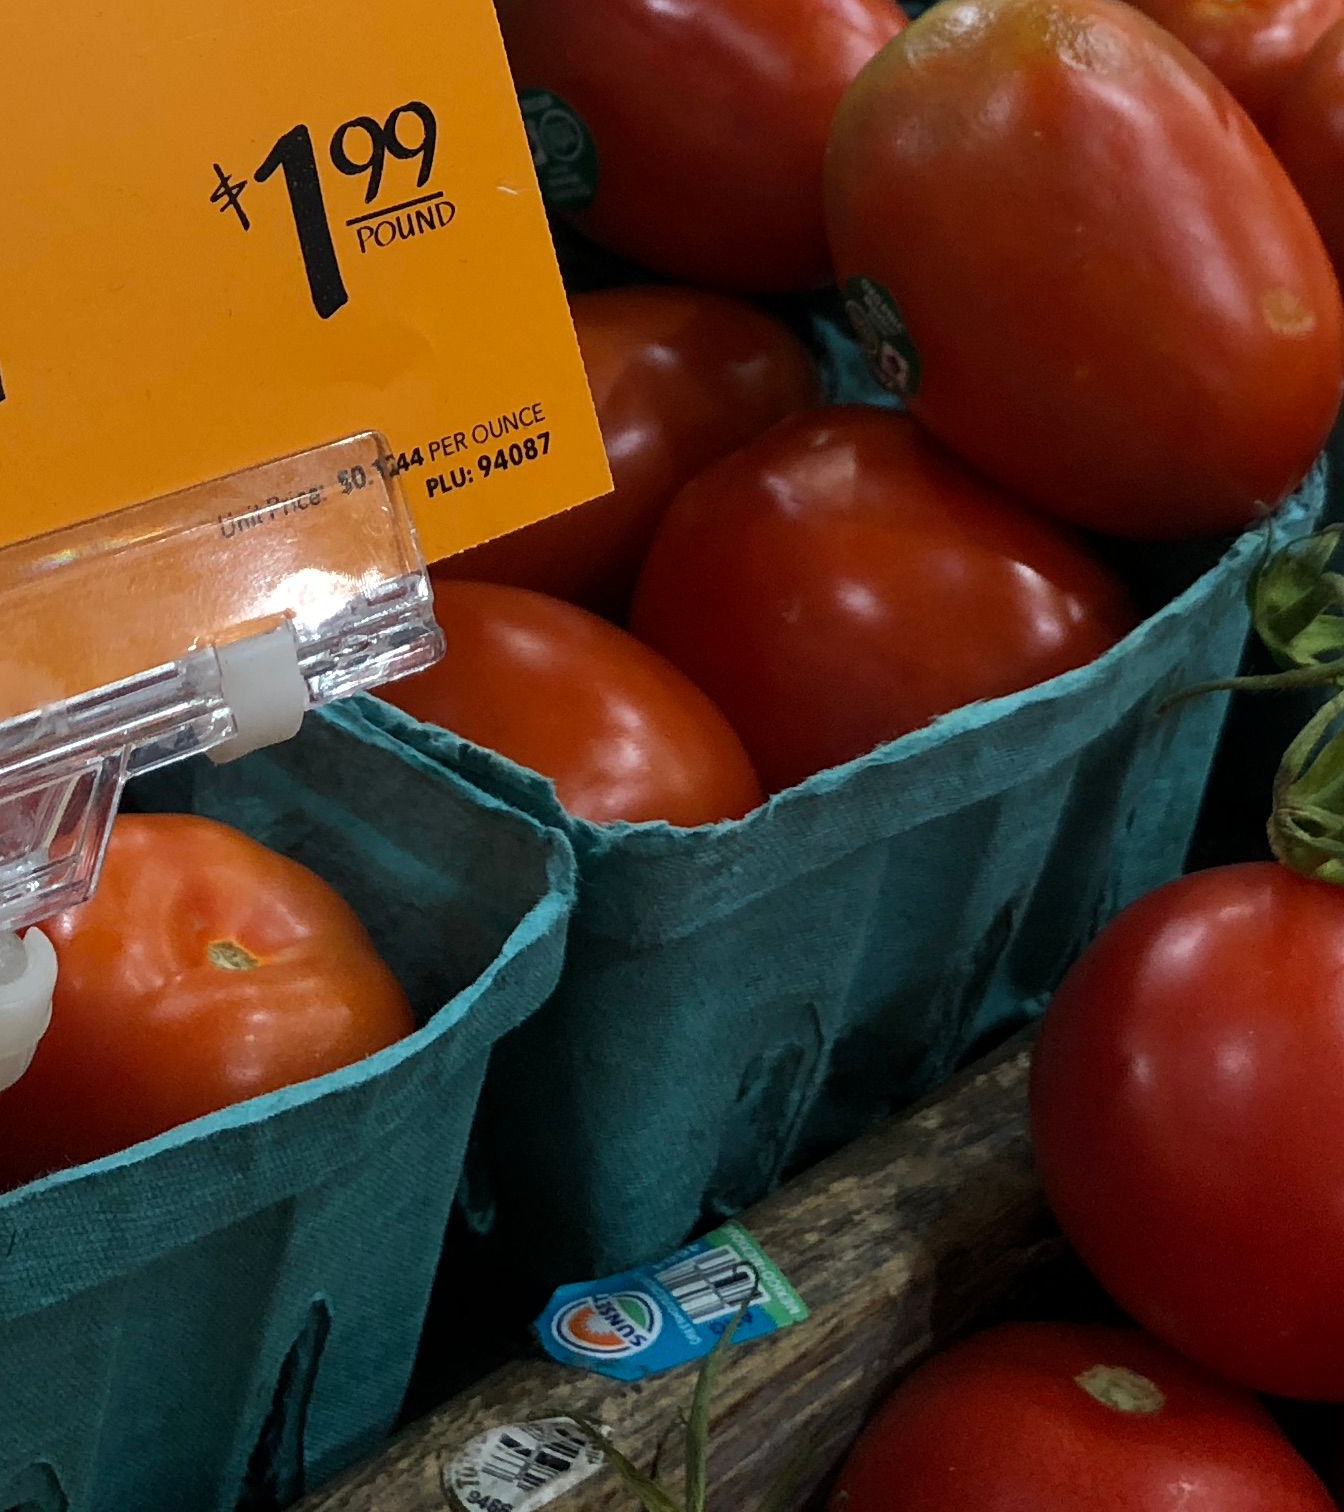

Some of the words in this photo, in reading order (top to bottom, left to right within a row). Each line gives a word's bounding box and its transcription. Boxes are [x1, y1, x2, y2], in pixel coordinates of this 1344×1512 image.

[356, 200, 456, 254] POUND
[218, 498, 262, 539] Unit
[428, 431, 468, 463] PER
[471, 402, 546, 445] OUNCE
[425, 467, 474, 498] PLU:
[477, 431, 550, 478] 94087
[593, 1292, 648, 1348] SUNSET
